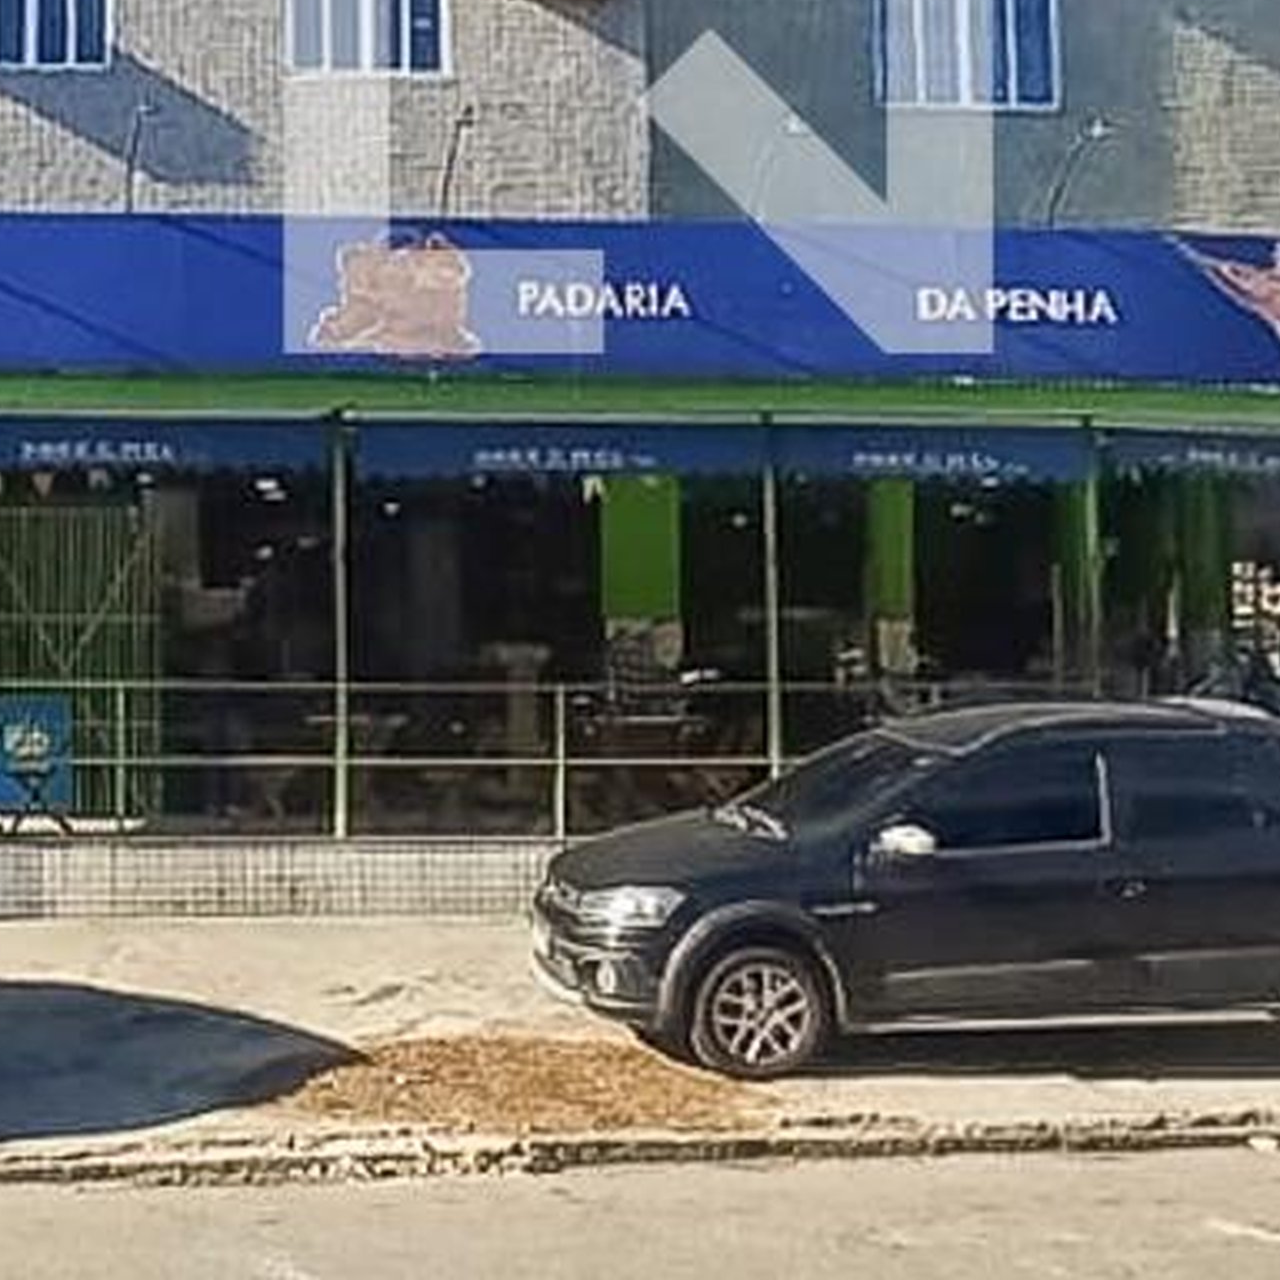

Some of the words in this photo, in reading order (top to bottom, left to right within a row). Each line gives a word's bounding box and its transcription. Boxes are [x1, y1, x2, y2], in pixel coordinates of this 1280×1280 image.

[517, 280, 692, 319] PADARIA
[916, 286, 977, 321] DA
[984, 287, 1119, 324] PENHA
